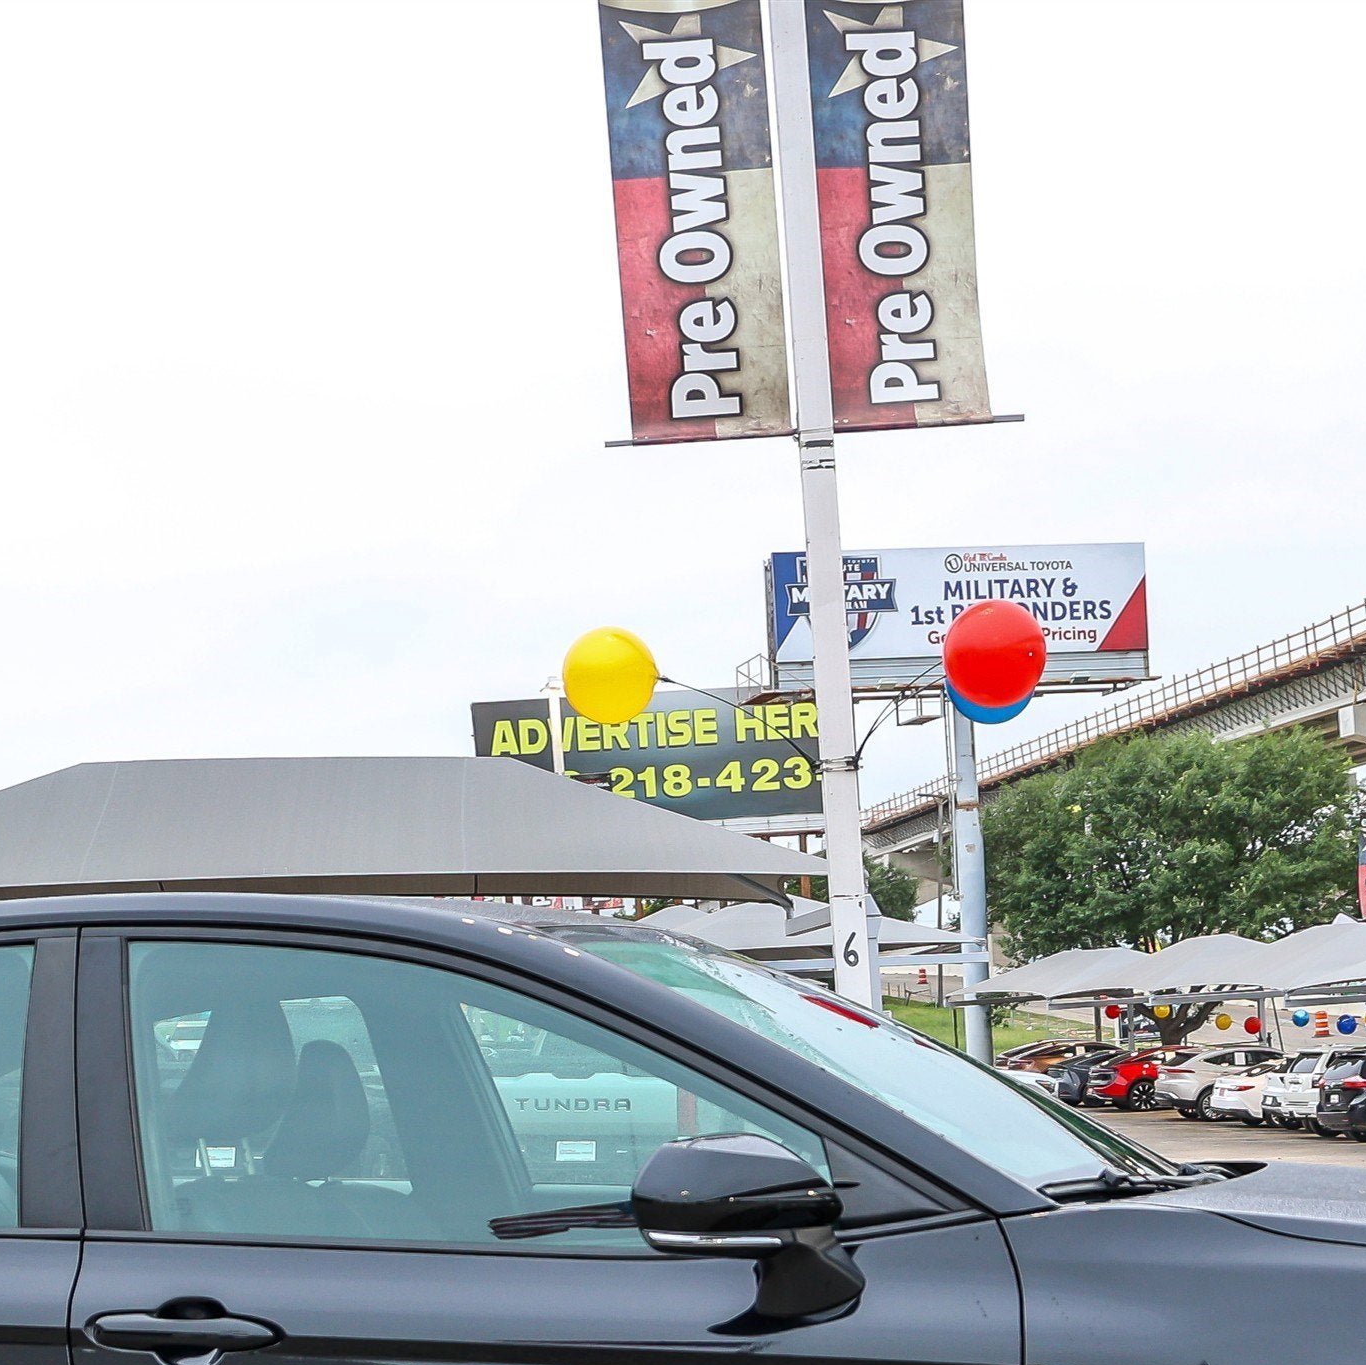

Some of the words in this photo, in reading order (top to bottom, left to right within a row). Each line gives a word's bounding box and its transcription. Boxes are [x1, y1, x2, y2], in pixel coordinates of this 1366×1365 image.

[642, 37, 732, 285] Owned
[844, 29, 930, 277] Owned
[671, 297, 741, 420] Pre
[870, 290, 940, 404] Pre
[963, 561, 1029, 573] UNIVERSAL
[1030, 560, 1073, 571] TOYOTA
[943, 578, 1057, 601] MILITARY
[1062, 576, 1078, 598] &
[910, 604, 946, 626] 1st
[1043, 625, 1098, 643] Pricing
[491, 708, 719, 756] ADVERTISE
[737, 702, 819, 742] HER
[843, 931, 859, 967] 6
[514, 1097, 632, 1112] TUNDRA
